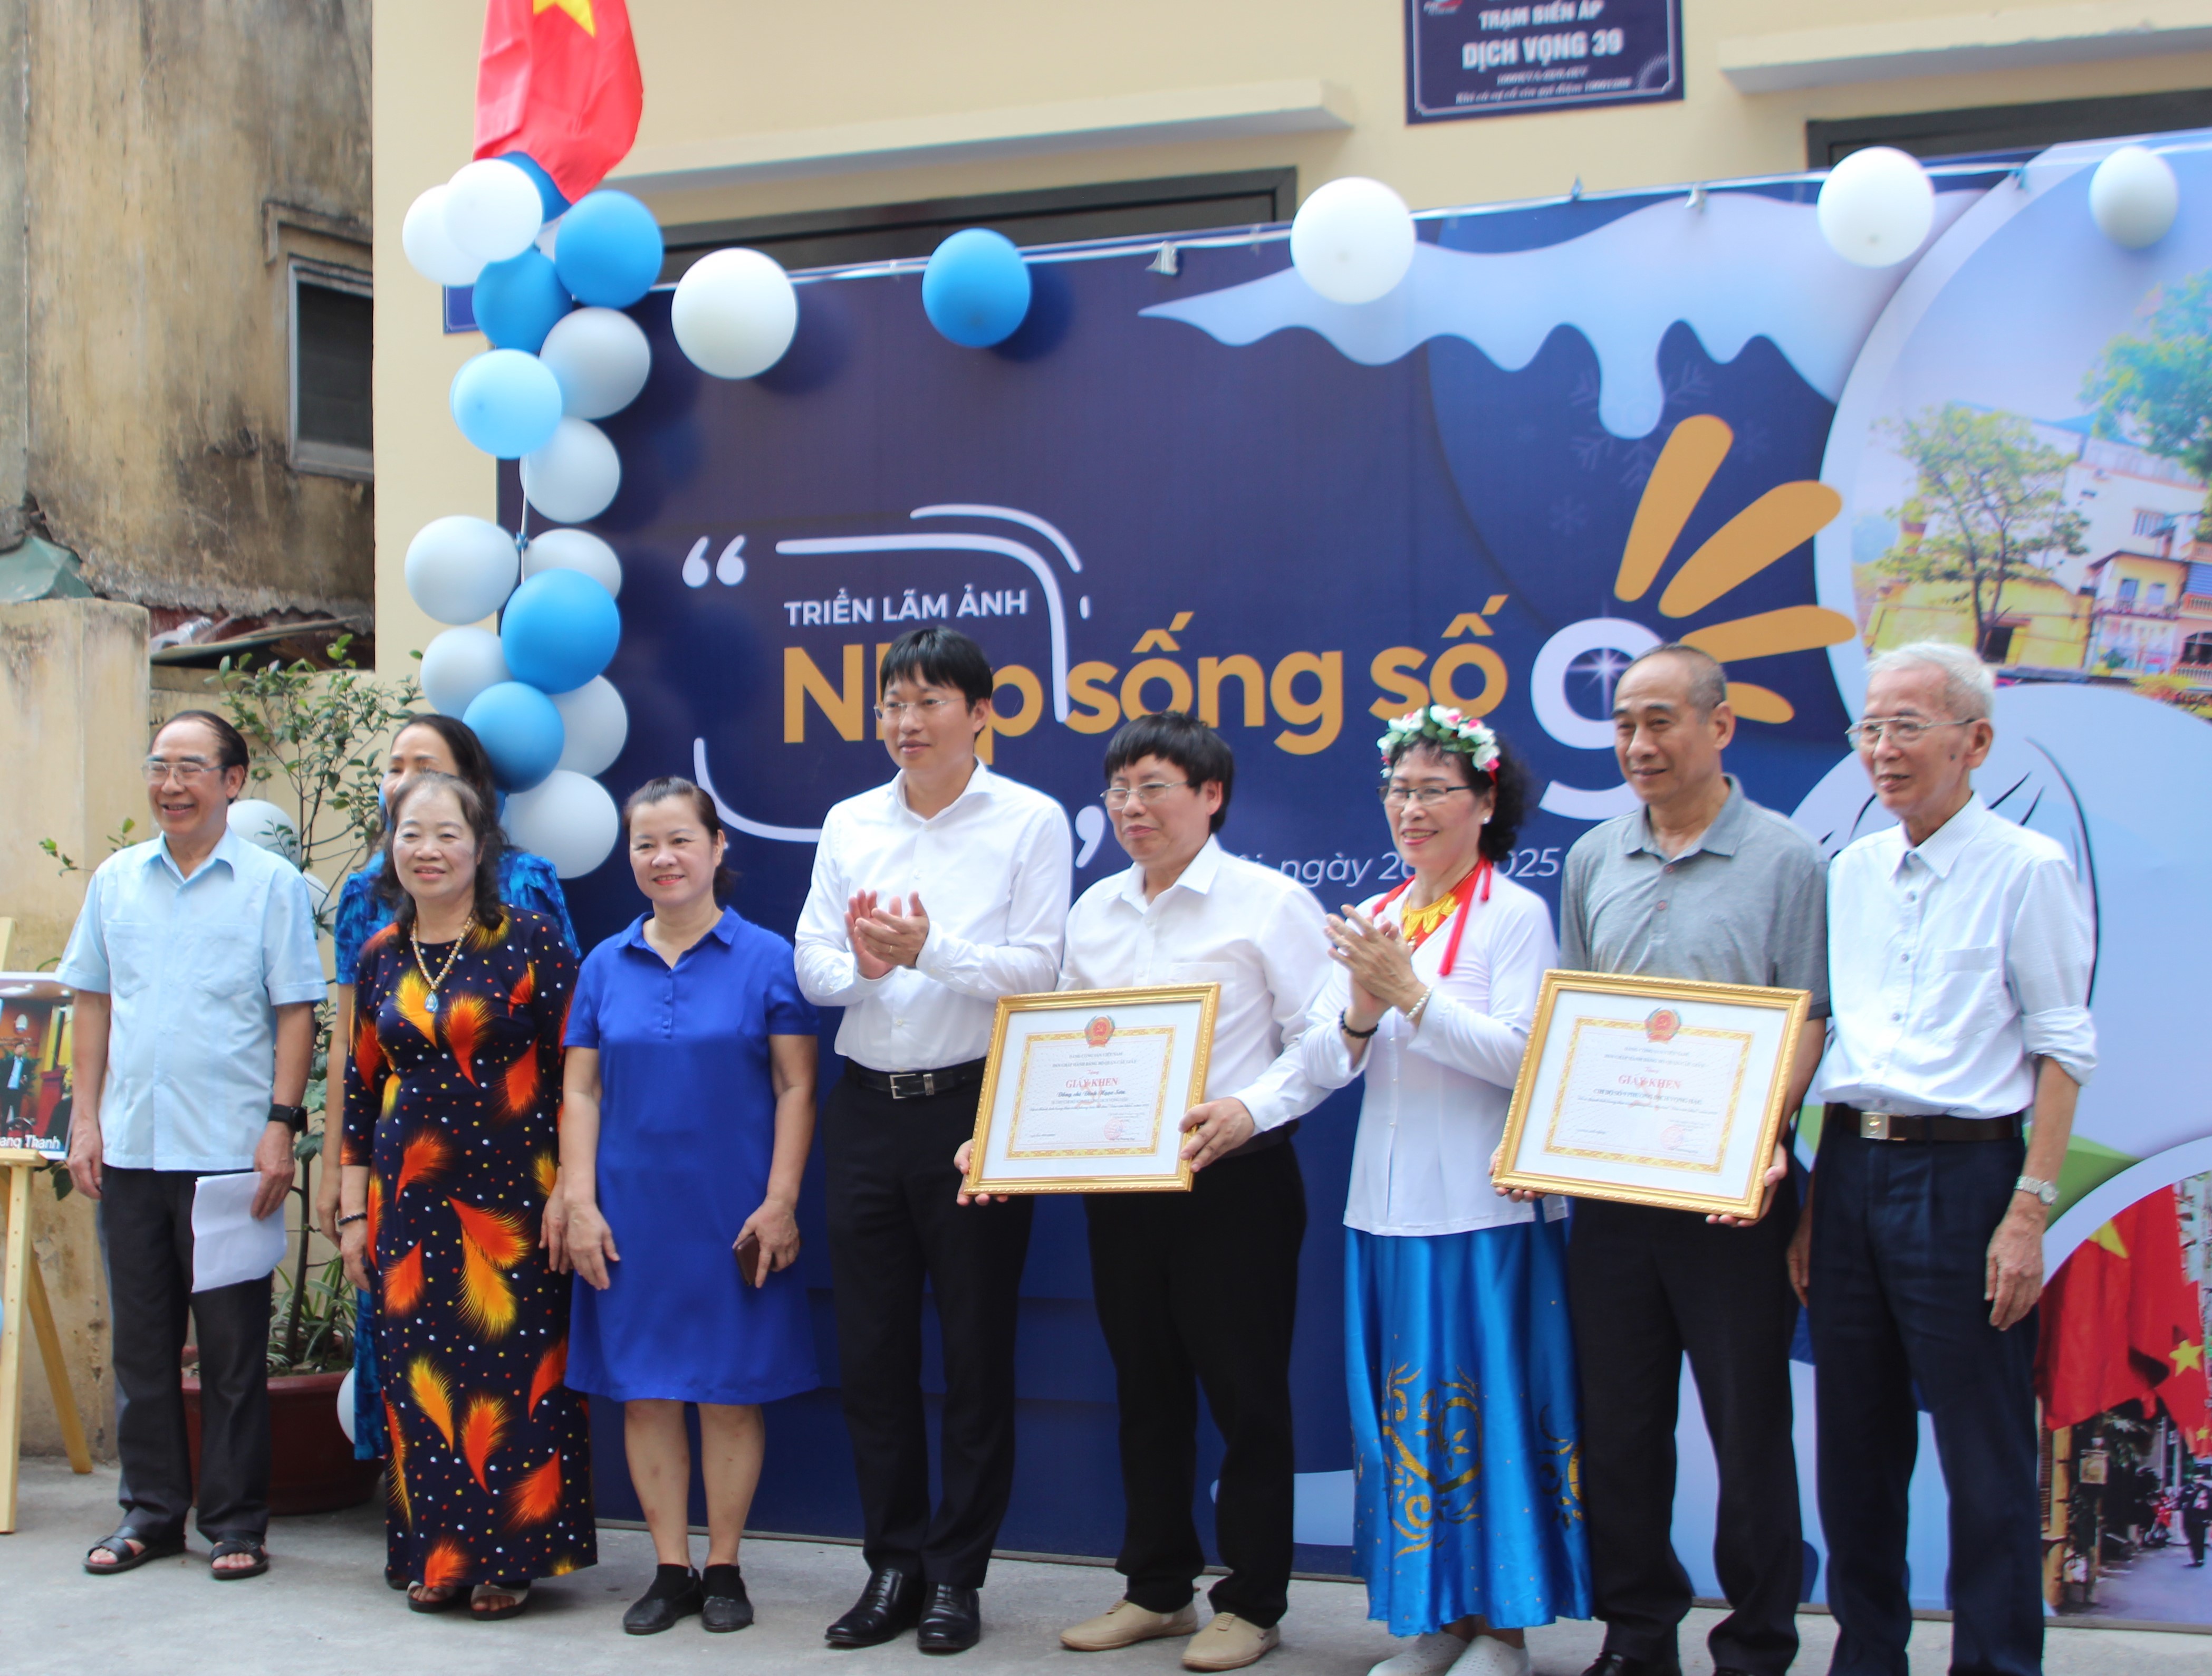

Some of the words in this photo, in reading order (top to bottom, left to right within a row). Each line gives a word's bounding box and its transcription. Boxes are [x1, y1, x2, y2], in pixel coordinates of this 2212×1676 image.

[1462, 37, 1519, 73] DỊCH
[1522, 31, 1588, 67] VỌNG
[1591, 27, 1624, 58] 39
[784, 588, 873, 626] TRIỂN
[883, 589, 948, 622] LÃM
[955, 583, 1028, 618] ẢNH
[784, 643, 1043, 764] Np
[1066, 611, 1342, 755] sống
[1368, 594, 1507, 721] số
[1280, 851, 1373, 887] ngày
[1065, 1076, 1090, 1088] GIẤY
[1091, 1078, 1119, 1087] KHEN
[1618, 1073, 1646, 1086] GIẤY
[1647, 1078, 1682, 1089] KHEN
[25, 1135, 61, 1149] Thanh
